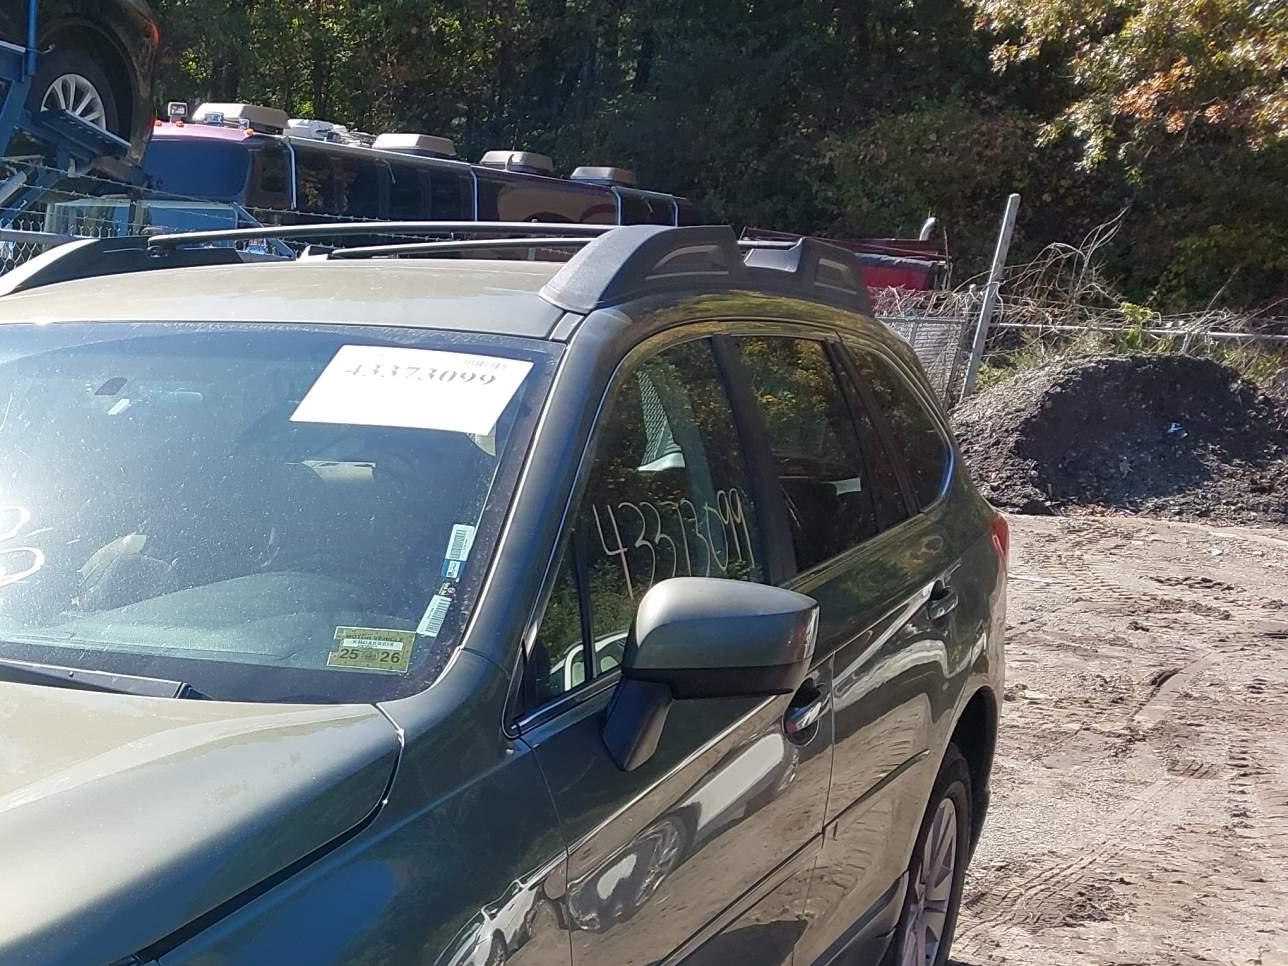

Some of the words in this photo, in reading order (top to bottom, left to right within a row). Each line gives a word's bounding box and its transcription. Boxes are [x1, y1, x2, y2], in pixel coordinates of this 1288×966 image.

[344, 362, 497, 386] 43373099
[592, 488, 755, 600] 43373099
[339, 648, 360, 660] 25
[379, 651, 401, 664] 26
